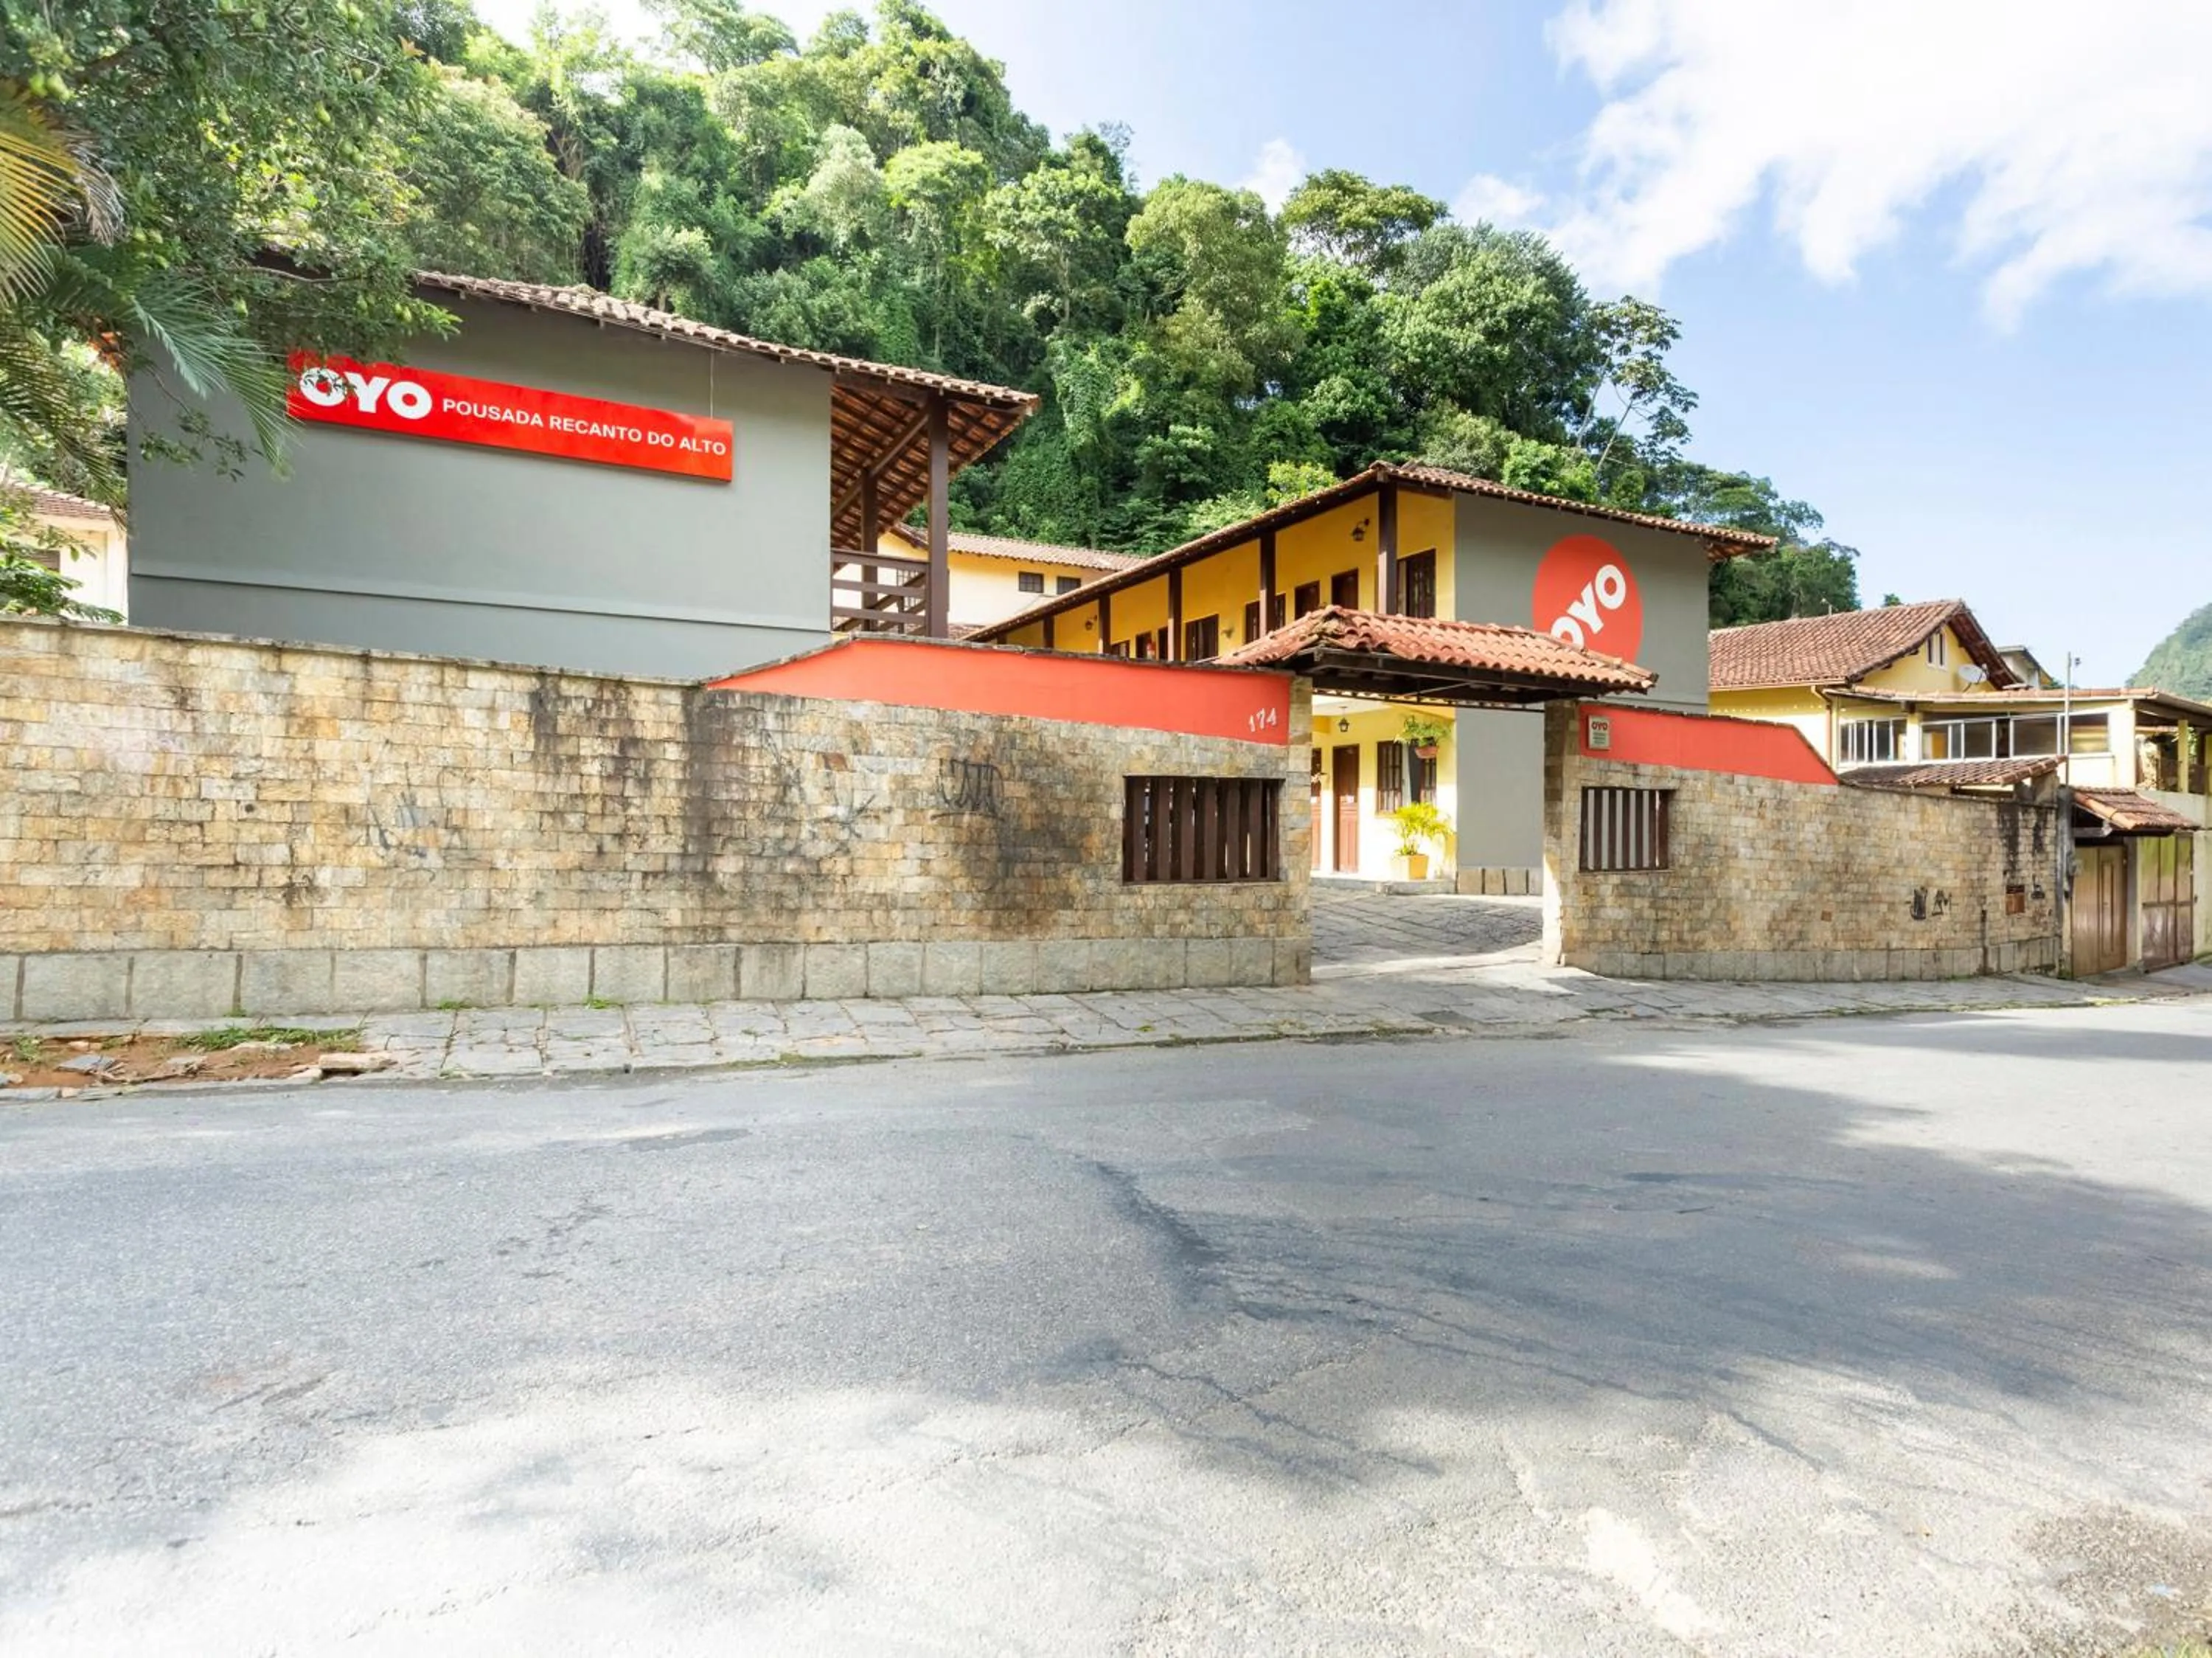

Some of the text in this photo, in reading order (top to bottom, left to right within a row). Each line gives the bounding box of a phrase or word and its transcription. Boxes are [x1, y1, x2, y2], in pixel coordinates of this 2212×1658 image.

[299, 366, 434, 420] OYO
[442, 398, 727, 457] POUSADA RECANTO DO ALTO
[1248, 707, 1277, 732] 174
[1591, 721, 1608, 731] OYO
